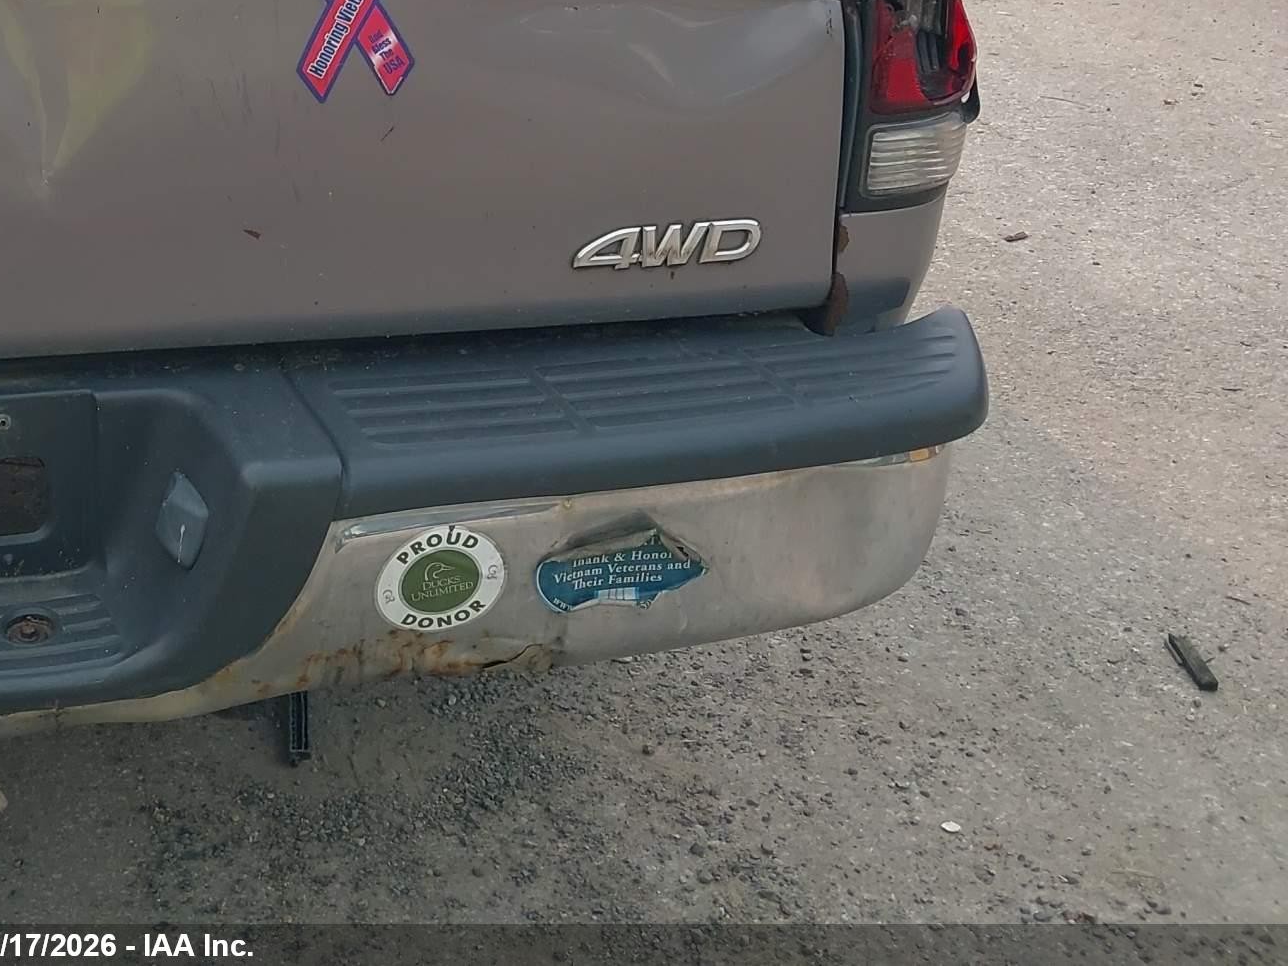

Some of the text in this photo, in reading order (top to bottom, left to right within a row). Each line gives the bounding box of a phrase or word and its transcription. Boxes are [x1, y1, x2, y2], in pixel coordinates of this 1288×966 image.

[308, 20, 349, 77] Honoring
[384, 56, 405, 74] USA
[572, 218, 761, 269] 4WD
[396, 531, 479, 565] PROUD
[614, 552, 626, 563] &
[423, 575, 462, 591] DUCKS
[554, 560, 691, 584] Vietnam Veterans and
[573, 572, 662, 591] Their Families
[411, 581, 474, 602] UNLIMITED
[400, 600, 486, 628] DONOR
